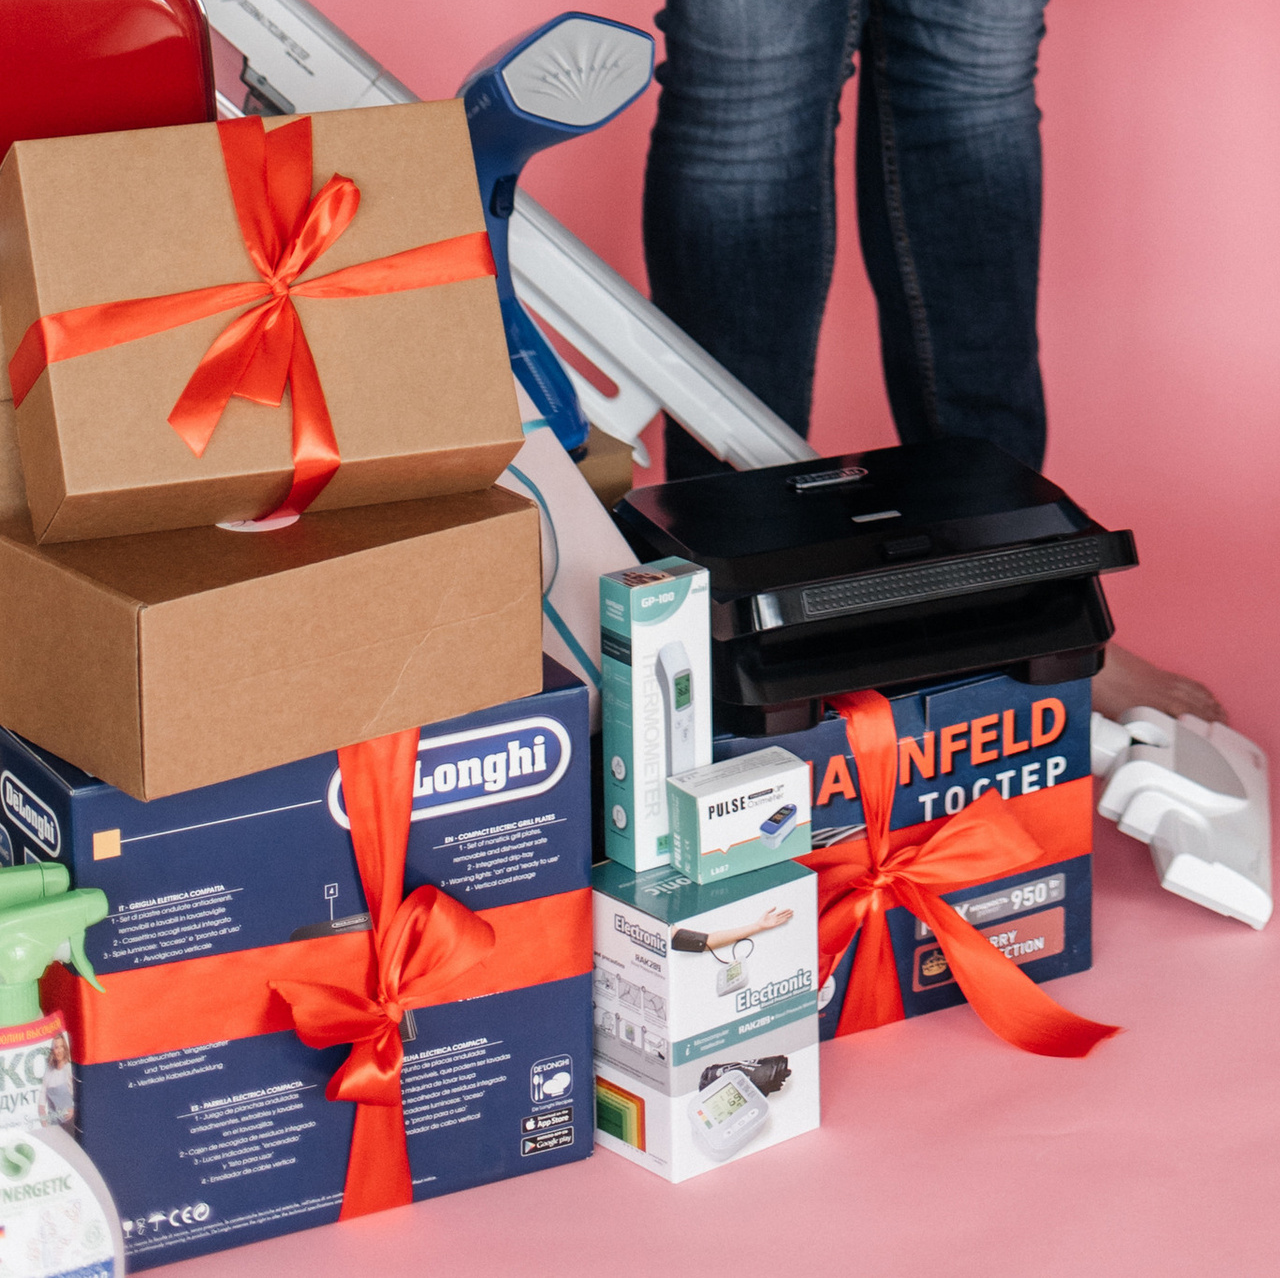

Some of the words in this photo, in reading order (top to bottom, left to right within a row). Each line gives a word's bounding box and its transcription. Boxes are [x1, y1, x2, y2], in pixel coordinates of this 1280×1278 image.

[641, 592, 675, 608] GP-100
[642, 650, 661, 820] THERMOMETER
[809, 697, 1067, 806] ANFELD
[412, 735, 547, 799] Longhi
[918, 755, 1067, 822] ТОСТЕР
[708, 796, 746, 820] PULSE
[457, 828, 489, 840] COMPACT
[490, 822, 517, 833] ELECTRIC
[517, 818, 534, 827] GRILL
[534, 813, 555, 823] PLATES
[510, 832, 521, 841] grill
[452, 851, 486, 863] removable
[486, 847, 499, 855] and
[500, 841, 533, 852] dishwasher
[534, 837, 547, 845] safe
[449, 875, 474, 885] Warning
[505, 864, 519, 872] and
[475, 856, 508, 869] Integrated
[473, 879, 497, 890] Vertical
[497, 876, 512, 885] cord
[513, 872, 536, 881] storage
[129, 899, 156, 910] GRIGLIA
[157, 892, 189, 904] ELETTRICA
[190, 884, 225, 897] COMPATTA
[1010, 883, 1047, 910] 950
[118, 922, 149, 934] removibili
[155, 916, 178, 926] lavabili
[186, 906, 225, 920] lavastoviglie
[138, 910, 160, 921] piastre
[161, 903, 190, 914] ondulate
[121, 932, 156, 944] Cassettino
[201, 916, 231, 927] integrato
[614, 913, 666, 952] Electronic
[990, 930, 1017, 948] RRY
[184, 942, 212, 953] verticale
[1000, 936, 1044, 958] CTION
[736, 968, 812, 1012] Electronic
[452, 1036, 487, 1050] COMPACTA
[431, 1056, 452, 1068] placas
[452, 1048, 485, 1061] onduladas
[439, 1067, 452, 1076] que
[452, 1061, 476, 1073] podem
[486, 1053, 510, 1064] lavadas
[406, 1090, 440, 1103] recolhedor
[476, 1074, 506, 1086] integrado
[442, 1076, 457, 1084] lavar
[0, 1089, 39, 1114] ДУКТ
[203, 1097, 231, 1109] PARRILLA
[266, 1080, 303, 1094] COMPACTA
[203, 1111, 222, 1120] Juego
[234, 1101, 264, 1114] planchas
[264, 1093, 299, 1106] onduladas
[276, 1102, 303, 1113] lavables
[433, 1110, 448, 1119] para
[440, 1118, 457, 1127] cabo
[457, 1112, 480, 1123] vertical
[537, 1119, 551, 1129] App
[552, 1114, 569, 1124] Store
[218, 1136, 248, 1148] recogida
[258, 1128, 284, 1139] residuos
[284, 1121, 316, 1133] integrado
[202, 1153, 220, 1162] Luces
[210, 1170, 241, 1182] Enrollador
[252, 1163, 271, 1172] cable
[272, 1156, 295, 1167] vertical
[242, 1156, 257, 1165] para
[2, 1174, 72, 1204] NERGETIC
